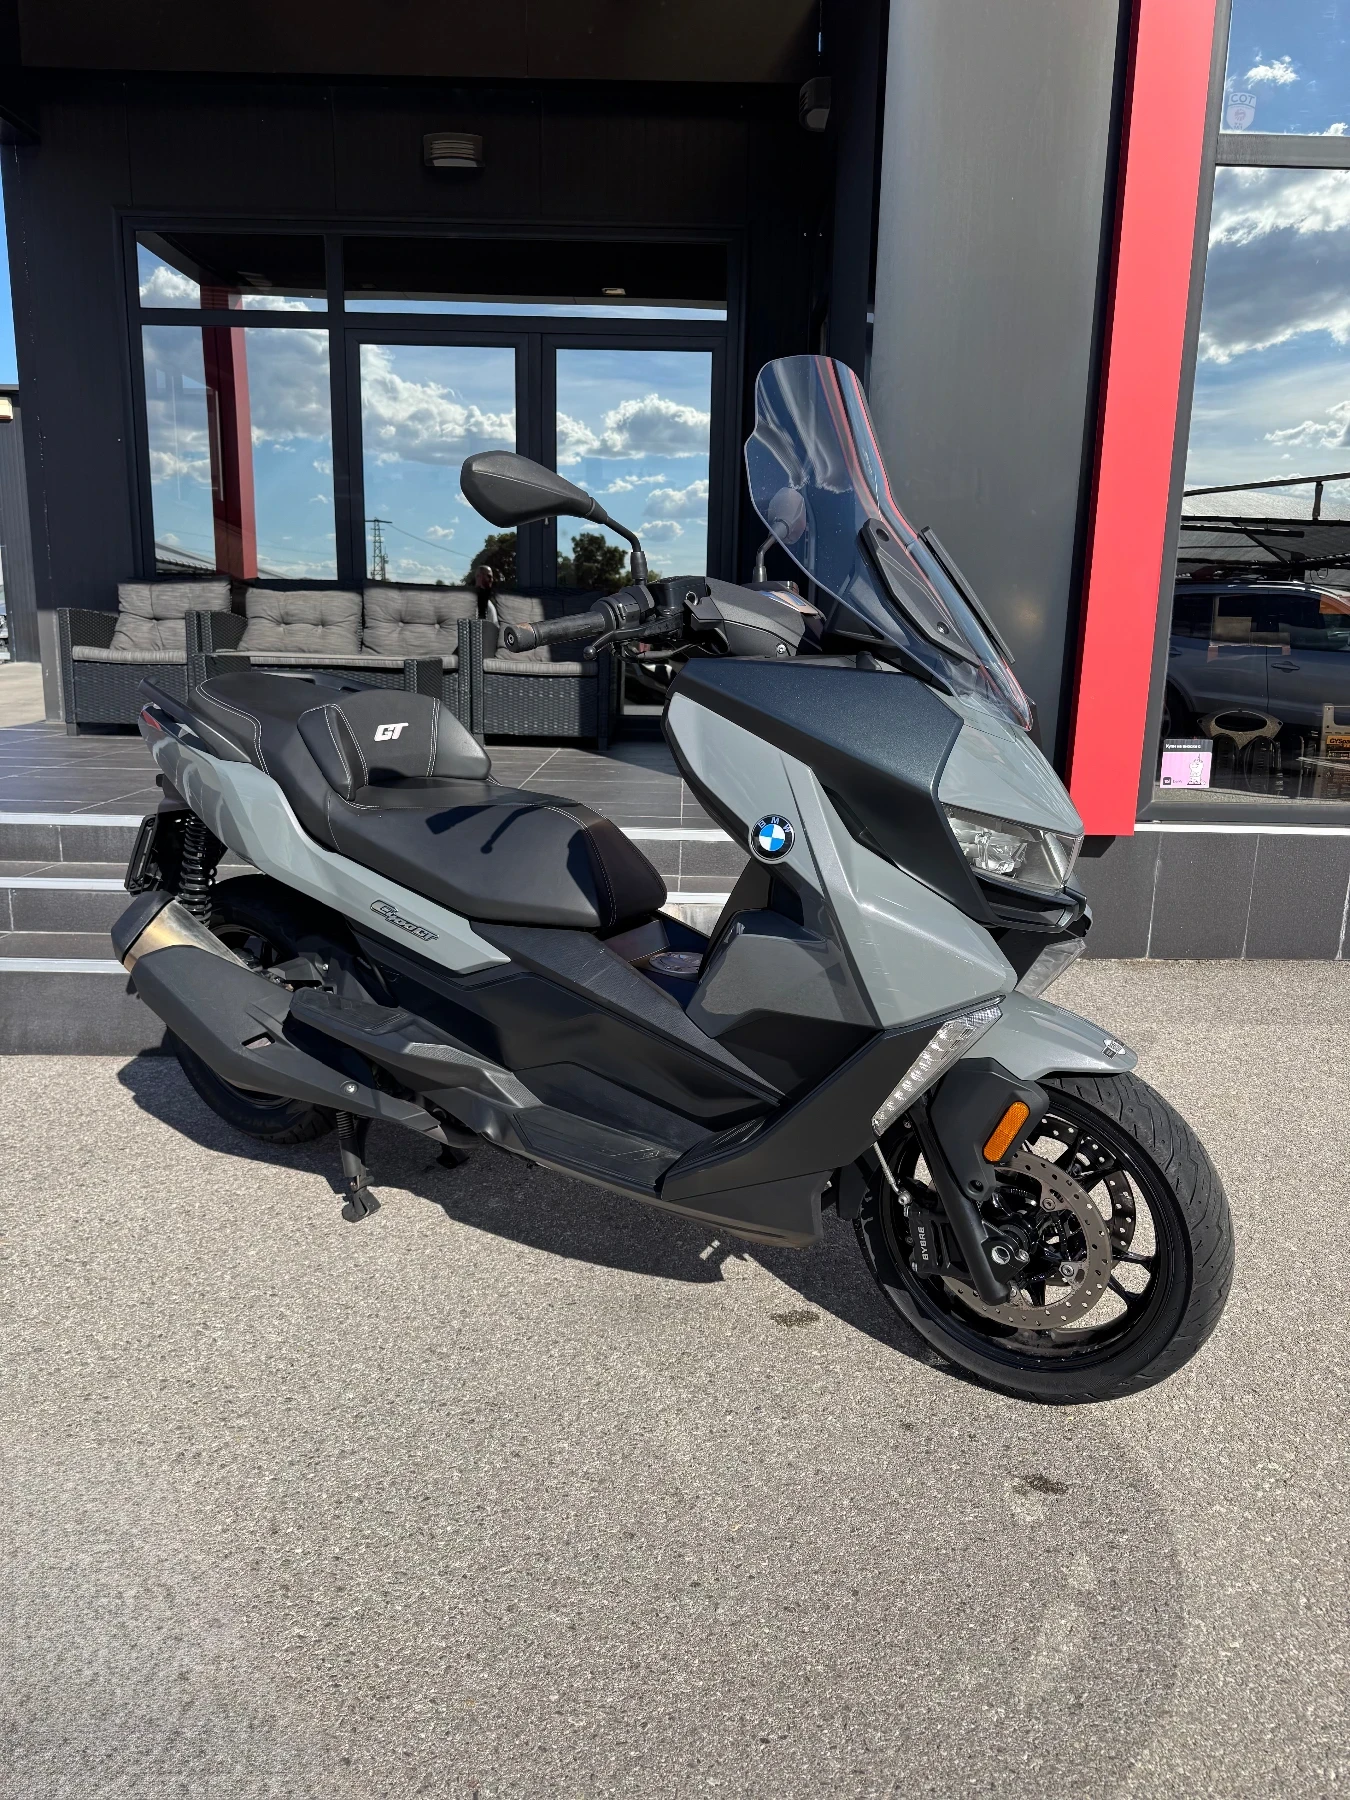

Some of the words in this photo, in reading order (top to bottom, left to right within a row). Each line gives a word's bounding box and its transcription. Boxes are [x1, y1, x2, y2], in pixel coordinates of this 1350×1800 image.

[374, 722, 409, 742] GT
[757, 816, 792, 833] BMW
[917, 1226, 929, 1261] BYBRE
